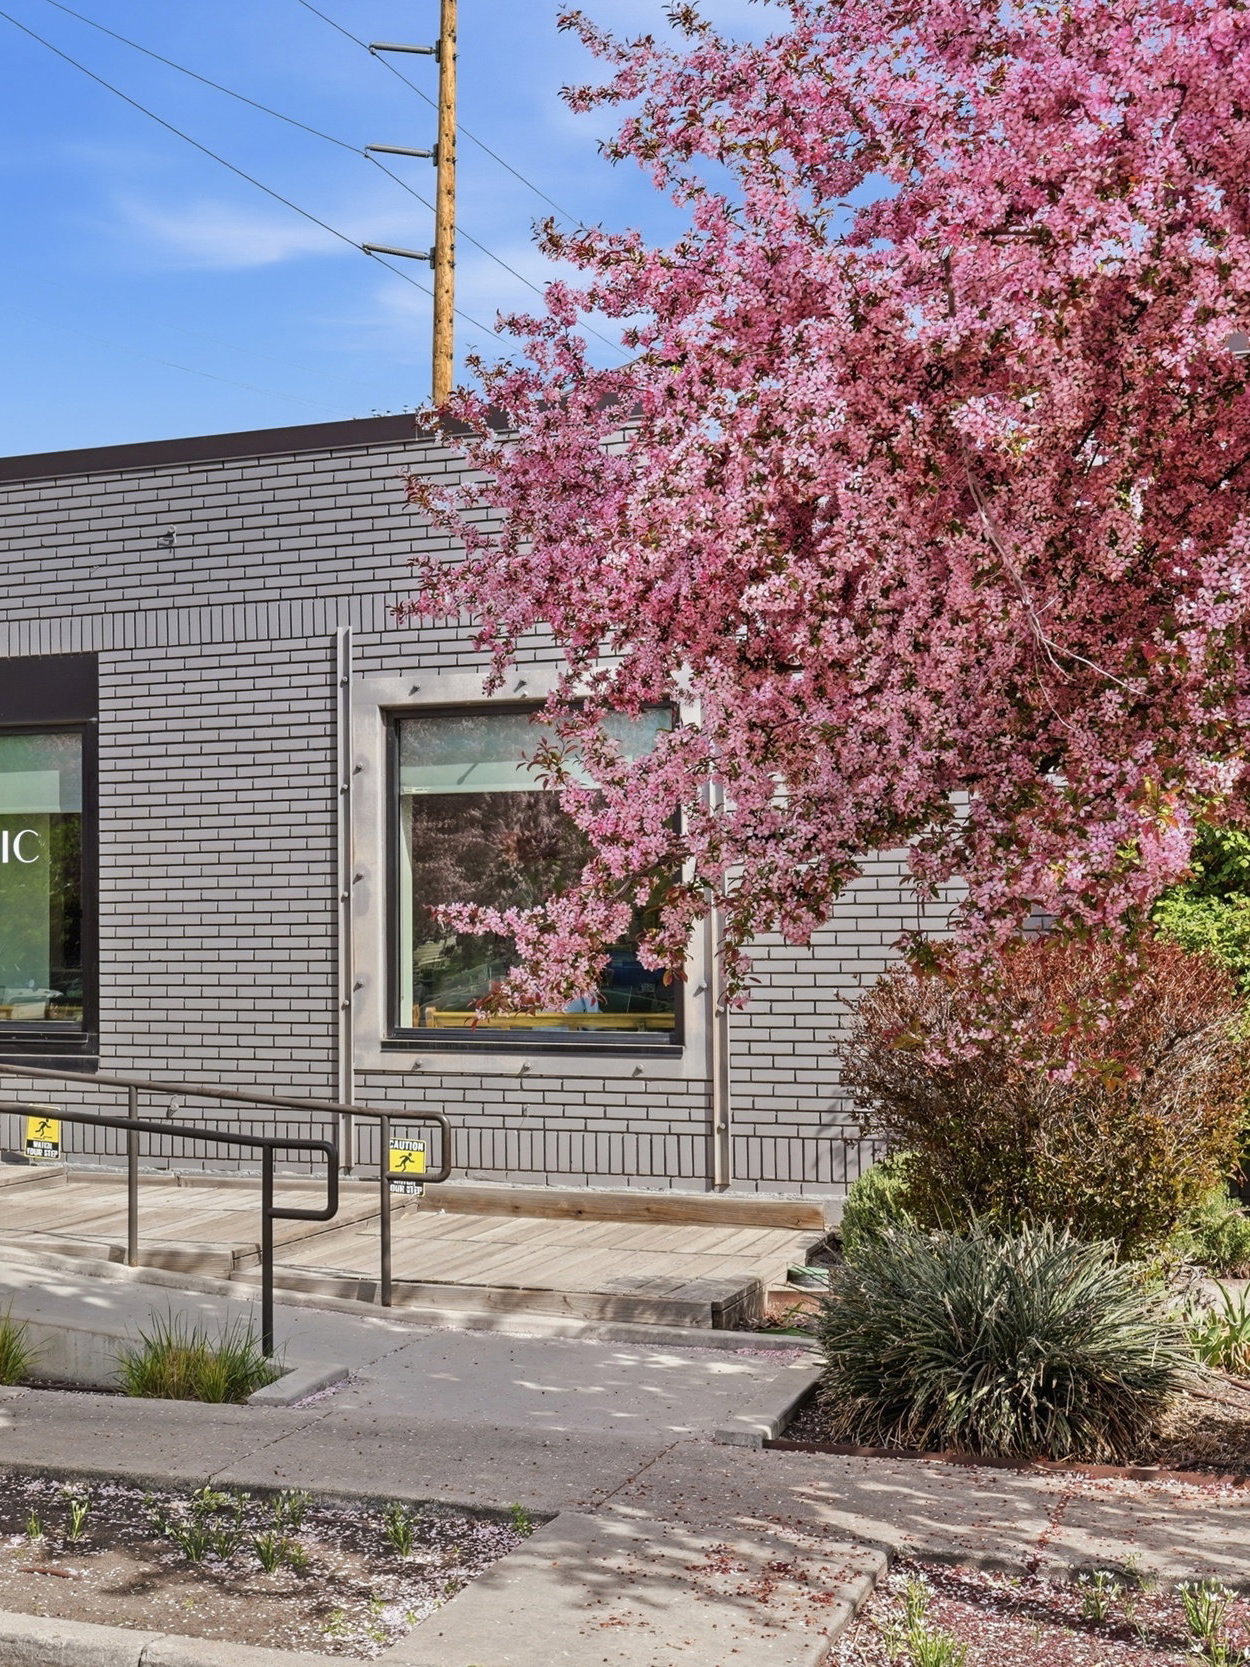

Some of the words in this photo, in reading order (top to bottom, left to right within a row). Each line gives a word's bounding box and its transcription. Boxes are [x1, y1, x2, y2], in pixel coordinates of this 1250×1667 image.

[33, 1141, 52, 1149] WATCH
[390, 1140, 424, 1151] CAUTION
[44, 1149, 58, 1157] STEP
[390, 1184, 404, 1193] OUR
